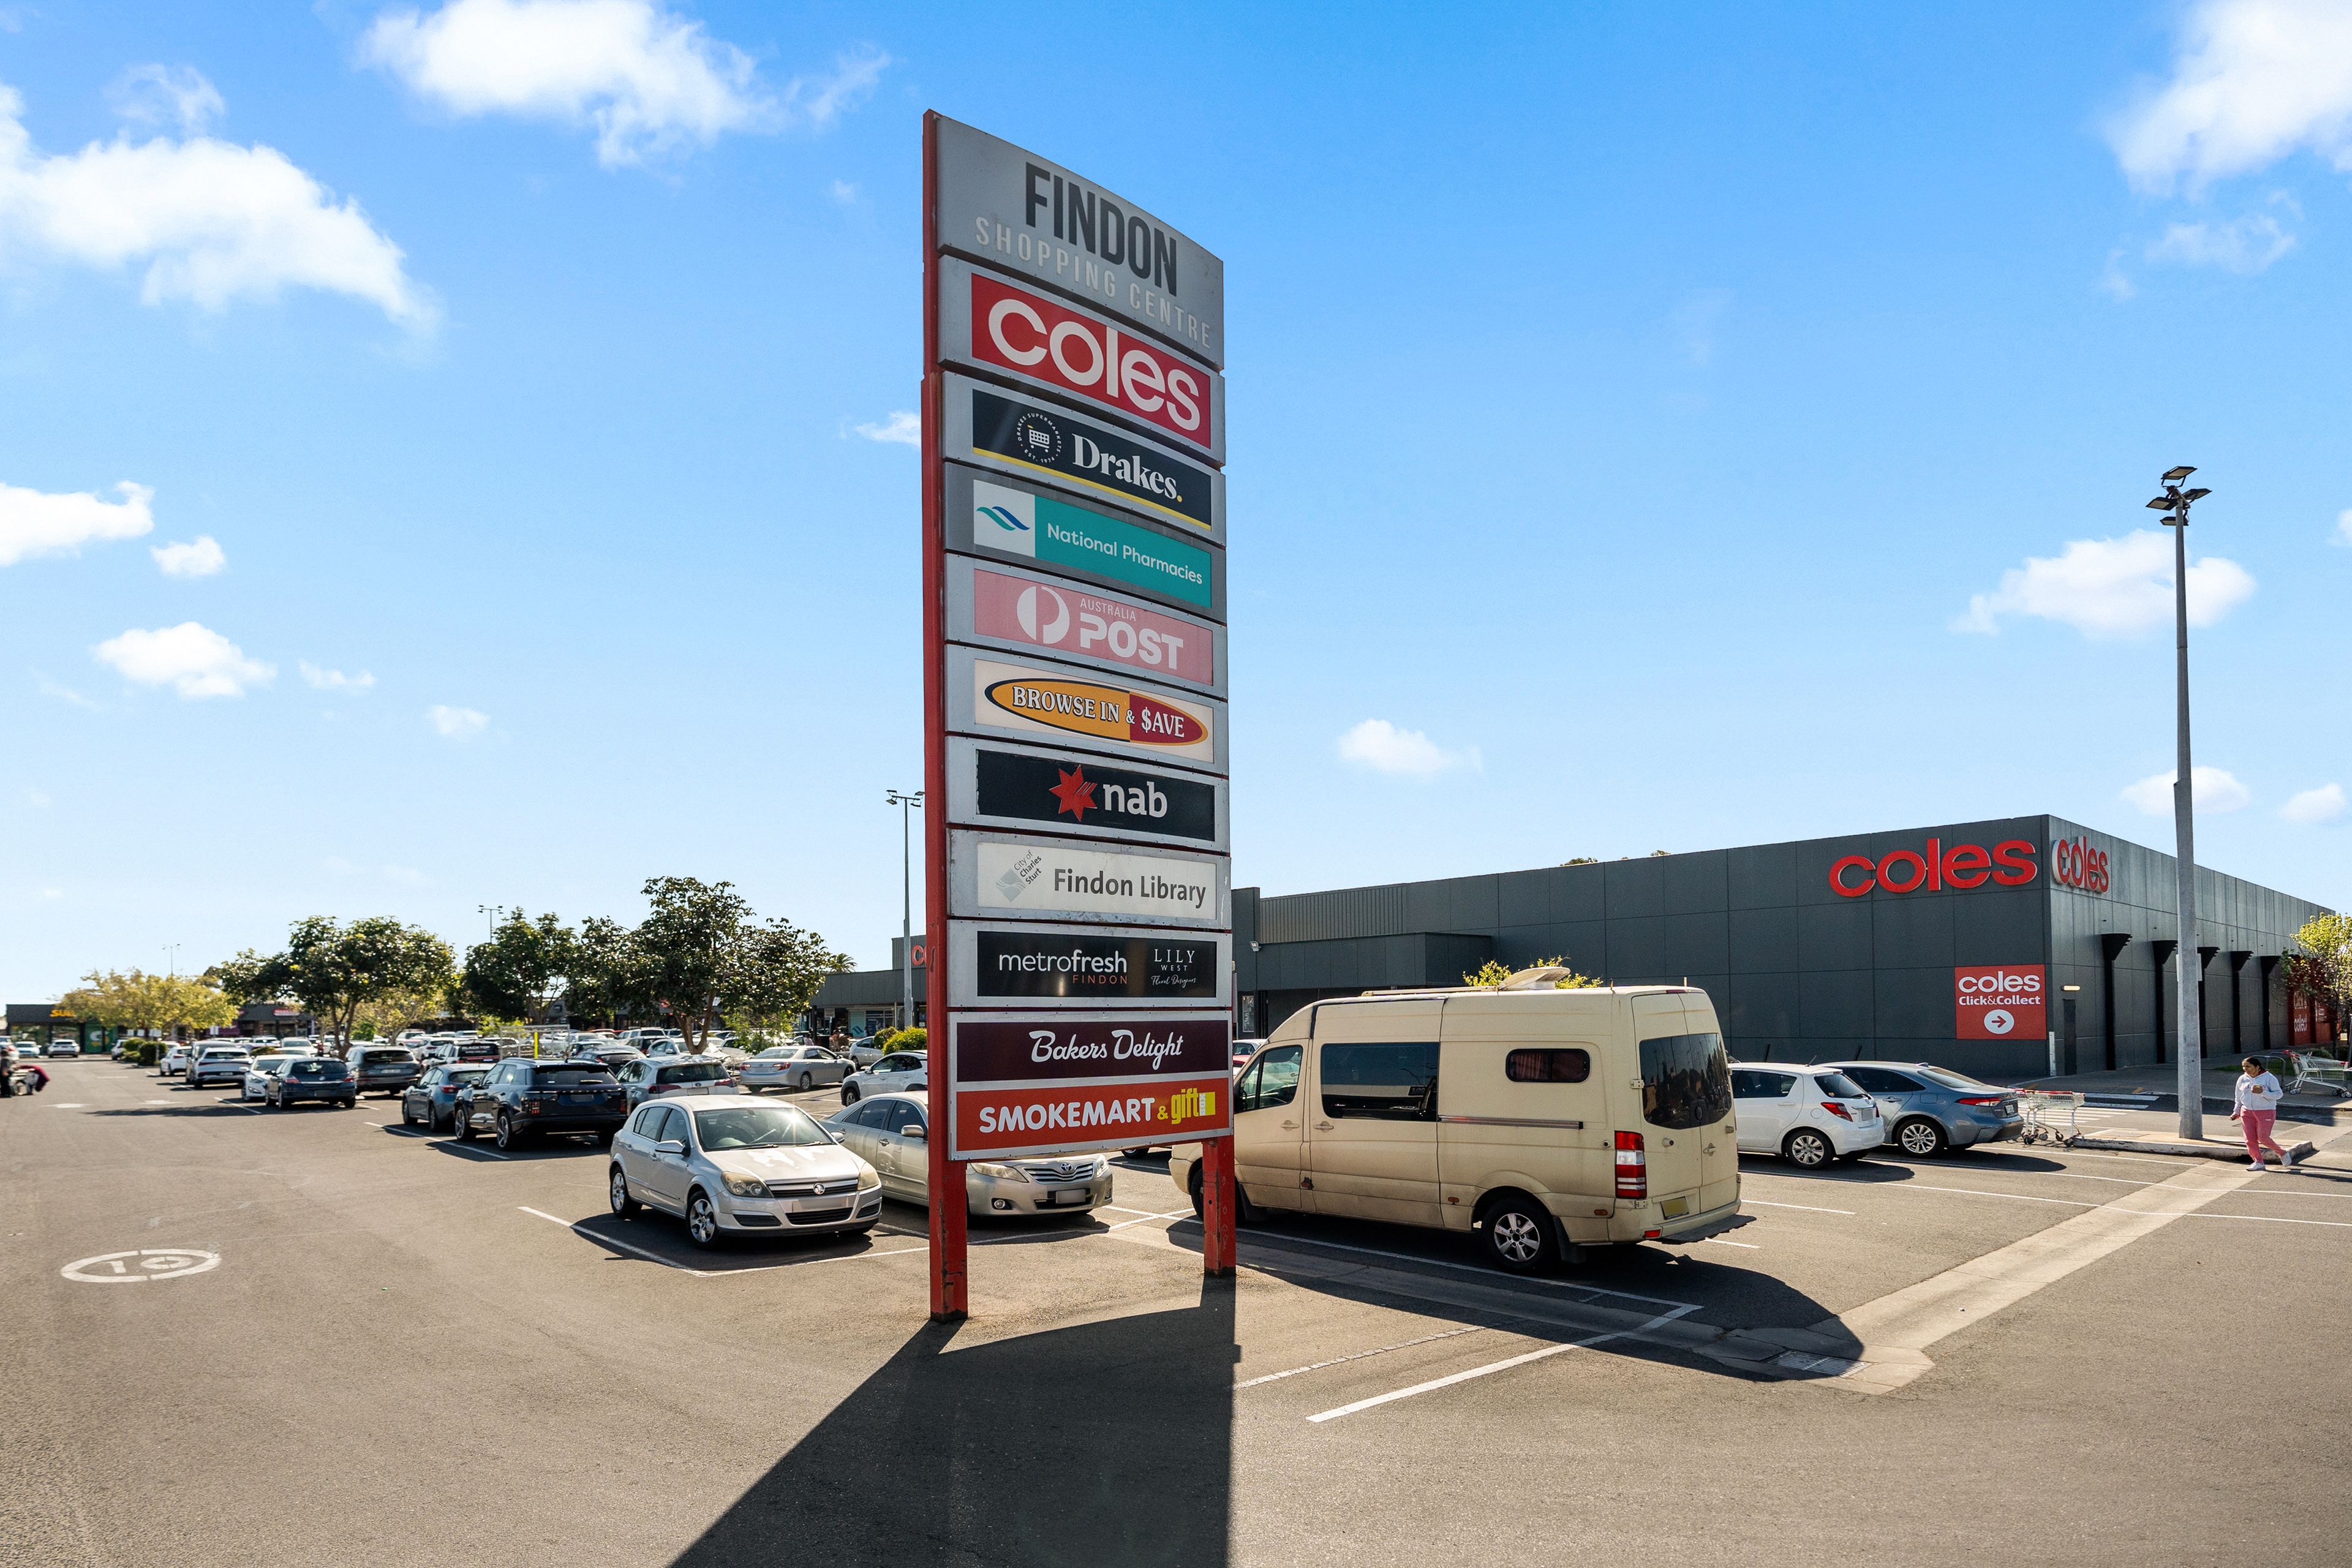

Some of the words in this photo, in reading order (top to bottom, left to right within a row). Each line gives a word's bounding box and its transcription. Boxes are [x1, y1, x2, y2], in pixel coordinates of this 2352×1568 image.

[1025, 162, 1177, 297] FINDON
[976, 216, 1115, 298] SHOPPING
[1129, 282, 1210, 349] CENTRE
[988, 298, 1200, 431] coles
[1017, 416, 1027, 441] DRAKES
[1027, 413, 1061, 453] SUPERMARKETS
[1047, 522, 1117, 557] National
[1123, 545, 1202, 585] Pharmacies
[1080, 598, 1136, 622] AUSTRALIA
[1080, 613, 1183, 670] POST
[1012, 685, 1096, 718] BROWSE
[1100, 701, 1120, 723] IN
[1125, 709, 1135, 724] &
[1142, 706, 1185, 738] $AVE
[1103, 781, 1167, 818] nab
[1014, 858, 1027, 870] City
[1026, 849, 1033, 859] of
[1020, 856, 1042, 877] Charles
[1025, 868, 1042, 884] Sturt
[1829, 838, 2038, 897] coles
[2052, 835, 2109, 894] coles
[1054, 868, 1133, 896] Findon
[1140, 876, 1207, 909] Library
[999, 949, 1127, 973] metrofresh
[1154, 949, 1195, 963] LILY
[1072, 974, 1128, 984] FINDON
[1958, 971, 2041, 993] coles
[1028, 1030, 1107, 1063] Bakers
[1111, 1029, 1183, 1070] Delight
[979, 1097, 1155, 1133] SMOKEMART
[1157, 1106, 1169, 1120] &
[1171, 1088, 1199, 1125] gift
